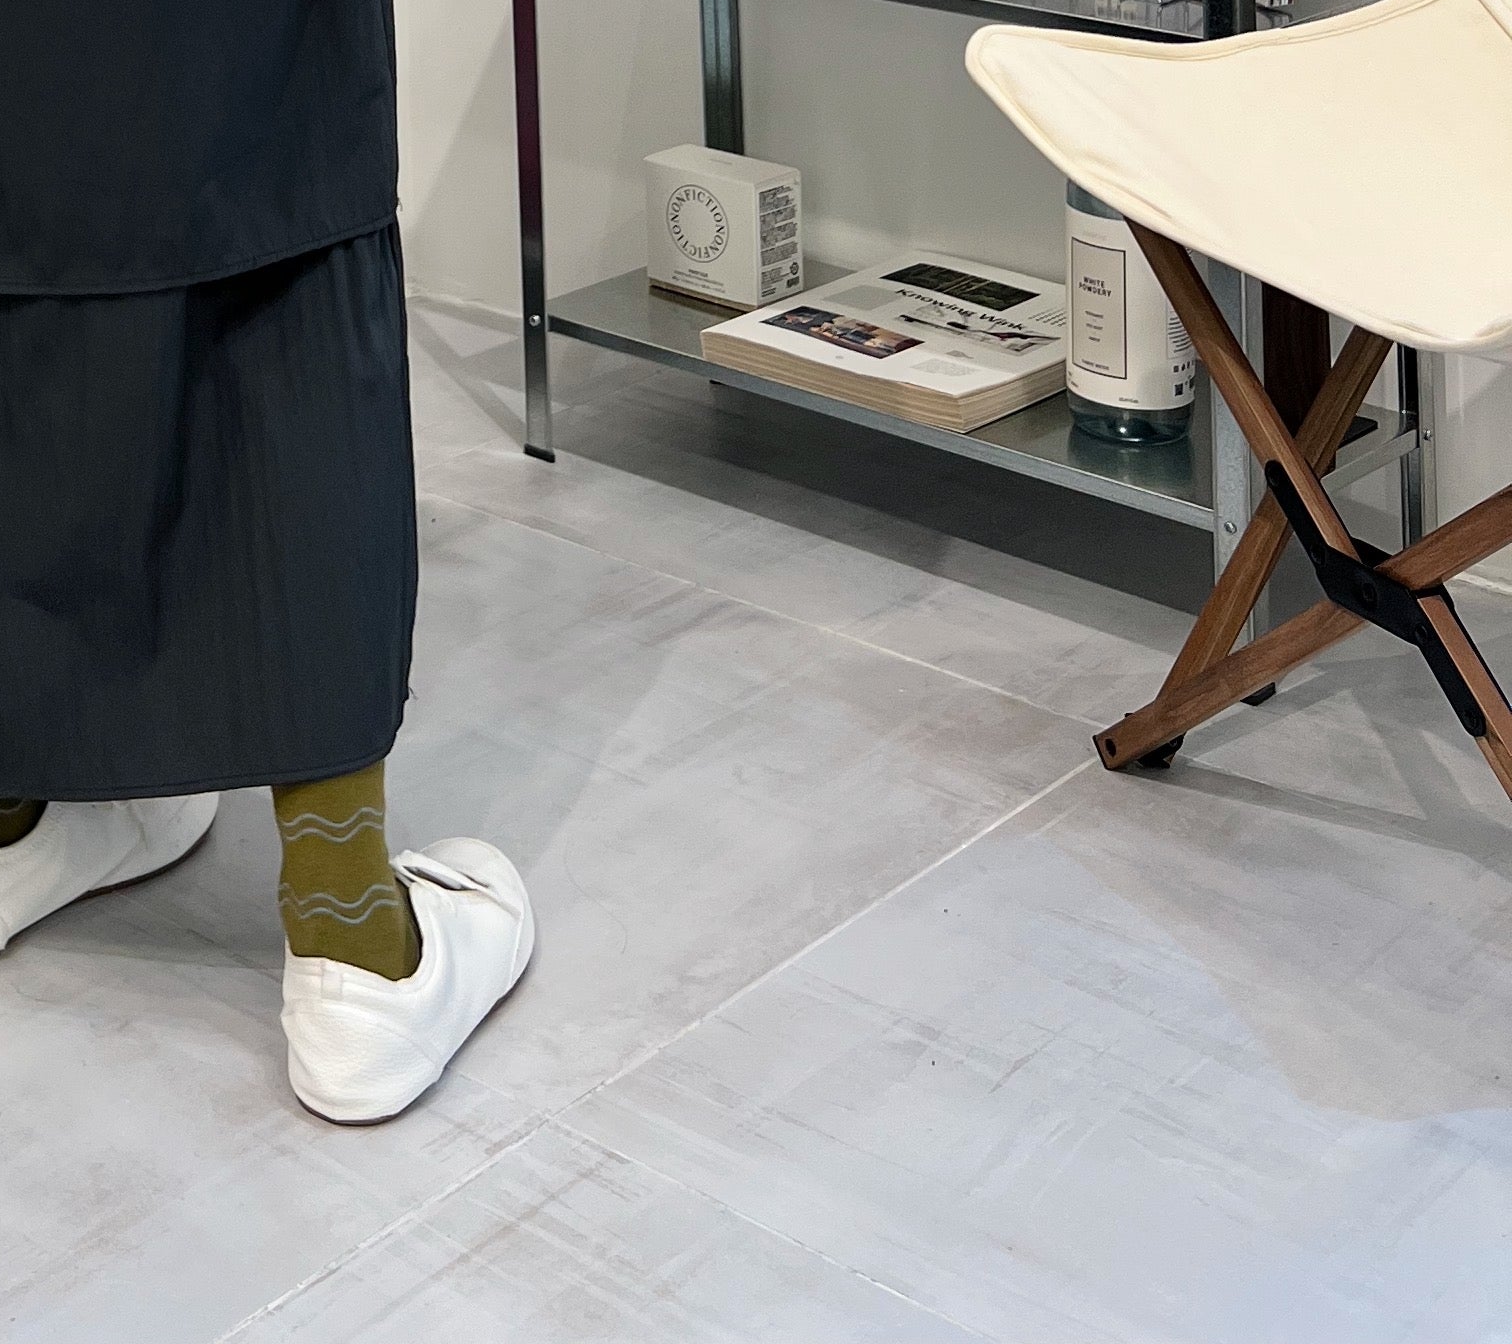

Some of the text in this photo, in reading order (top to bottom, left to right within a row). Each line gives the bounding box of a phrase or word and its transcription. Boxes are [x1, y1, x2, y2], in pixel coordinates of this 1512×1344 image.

[1078, 282, 1112, 297] POWDERY
[1083, 276, 1105, 289] WHITE
[896, 288, 977, 318] Knowing
